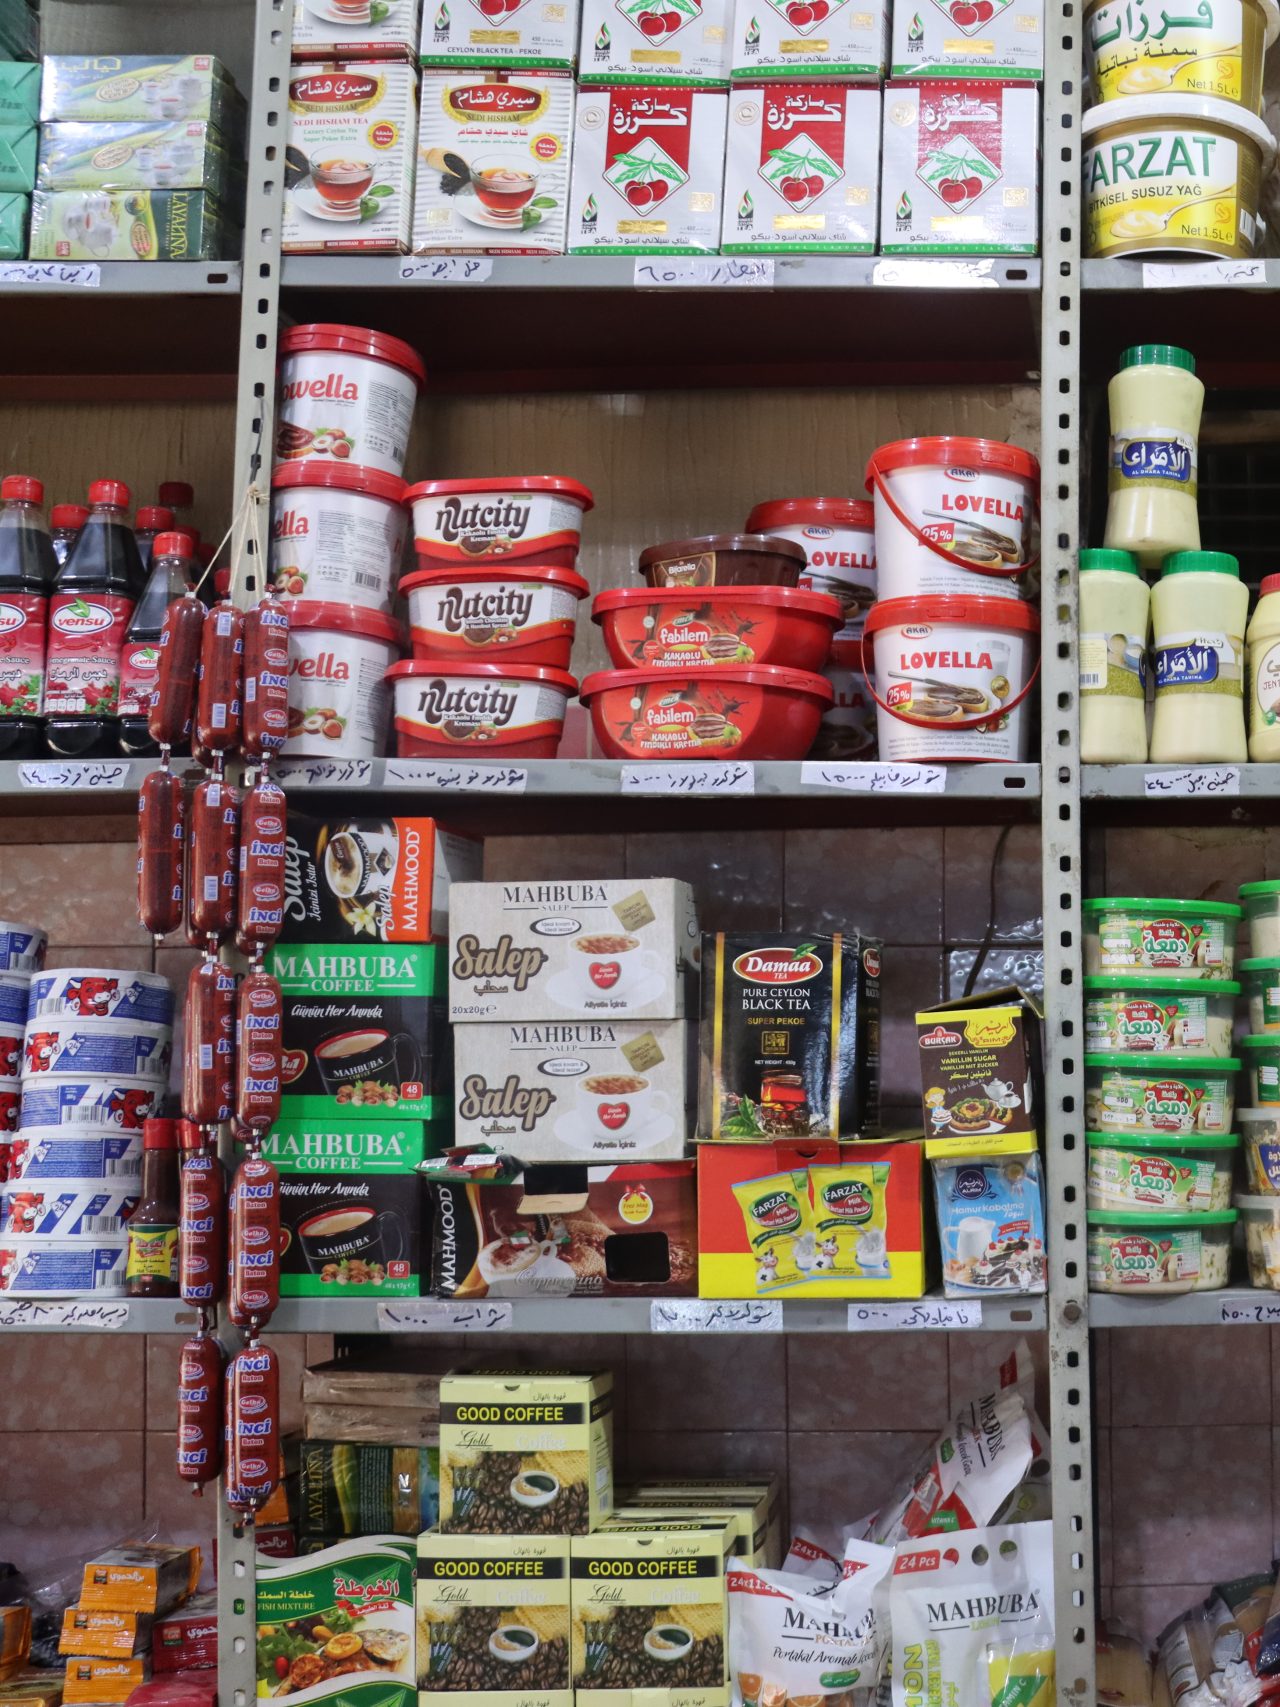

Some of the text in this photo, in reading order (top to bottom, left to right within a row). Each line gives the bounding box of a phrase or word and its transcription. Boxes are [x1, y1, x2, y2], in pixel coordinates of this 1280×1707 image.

[1088, 0, 1214, 52] فرزات
[447, 46, 474, 54] CEYLON
[1143, 41, 1199, 58] سمنة
[296, 79, 372, 99] سيدي هشام
[306, 103, 358, 112] SEDI HISHAM
[457, 90, 535, 110] سيدي هشام
[631, 98, 671, 115] ماركة
[786, 94, 825, 111] ماركة
[466, 113, 520, 122] SEDI HISHAM
[613, 104, 688, 135] كرزة
[767, 99, 842, 131] كرزة
[922, 99, 998, 132] كرزة
[1131, 186, 1174, 201] SUSUZ
[1177, 182, 1203, 198] YAĞ
[282, 373, 359, 401] owella
[942, 494, 1025, 521] LOVELLA
[58, 615, 105, 627] vensu
[659, 628, 709, 644] fabilem
[664, 651, 700, 661] KAKAOLU
[900, 651, 993, 671] LOVELLA
[647, 708, 695, 725] fabilem
[651, 732, 688, 742] KAKAOLU
[402, 830, 421, 931] MAHMOOD
[503, 884, 608, 904] MAHBUBA
[1143, 931, 1188, 955] دمعة
[273, 956, 417, 979] MAHBUBA
[453, 933, 550, 991] Salep
[745, 956, 812, 973] Damaa
[311, 979, 375, 992] COFFEE
[743, 988, 811, 997] PURE CEYLON
[291, 1004, 325, 1017] Günün
[325, 1005, 345, 1017] Her
[742, 999, 812, 1010] BLACK TEA
[777, 1017, 806, 1025] PEKOE
[1118, 1014, 1163, 1036] دمعة
[510, 1025, 617, 1044] MAHBUBA
[924, 1036, 957, 1046] BURÇAK
[333, 1058, 384, 1079] MAHBUBA
[941, 1054, 997, 1065] VANILLIN SUGAR
[459, 1073, 557, 1132] Salep
[260, 1133, 405, 1156] MAHBUBA
[295, 1156, 361, 1170] COFFEE
[1130, 1165, 1173, 1192] دمعة
[824, 1182, 864, 1202] FARZAT
[751, 1192, 788, 1218] FARZAT
[441, 1187, 457, 1291] MAHMOOD
[456, 1406, 564, 1421] GOOD COFFEE
[433, 1561, 544, 1577] GOOD COFFEE
[588, 1560, 698, 1576] GOOD COFFEE
[900, 1555, 937, 1570] 24 Pcs
[333, 1577, 400, 1600] الغوطة
[256, 1602, 316, 1612] FISH MIXTURE
[927, 1593, 1040, 1624] MAHBUBA
[773, 1646, 815, 1663] Portakal
